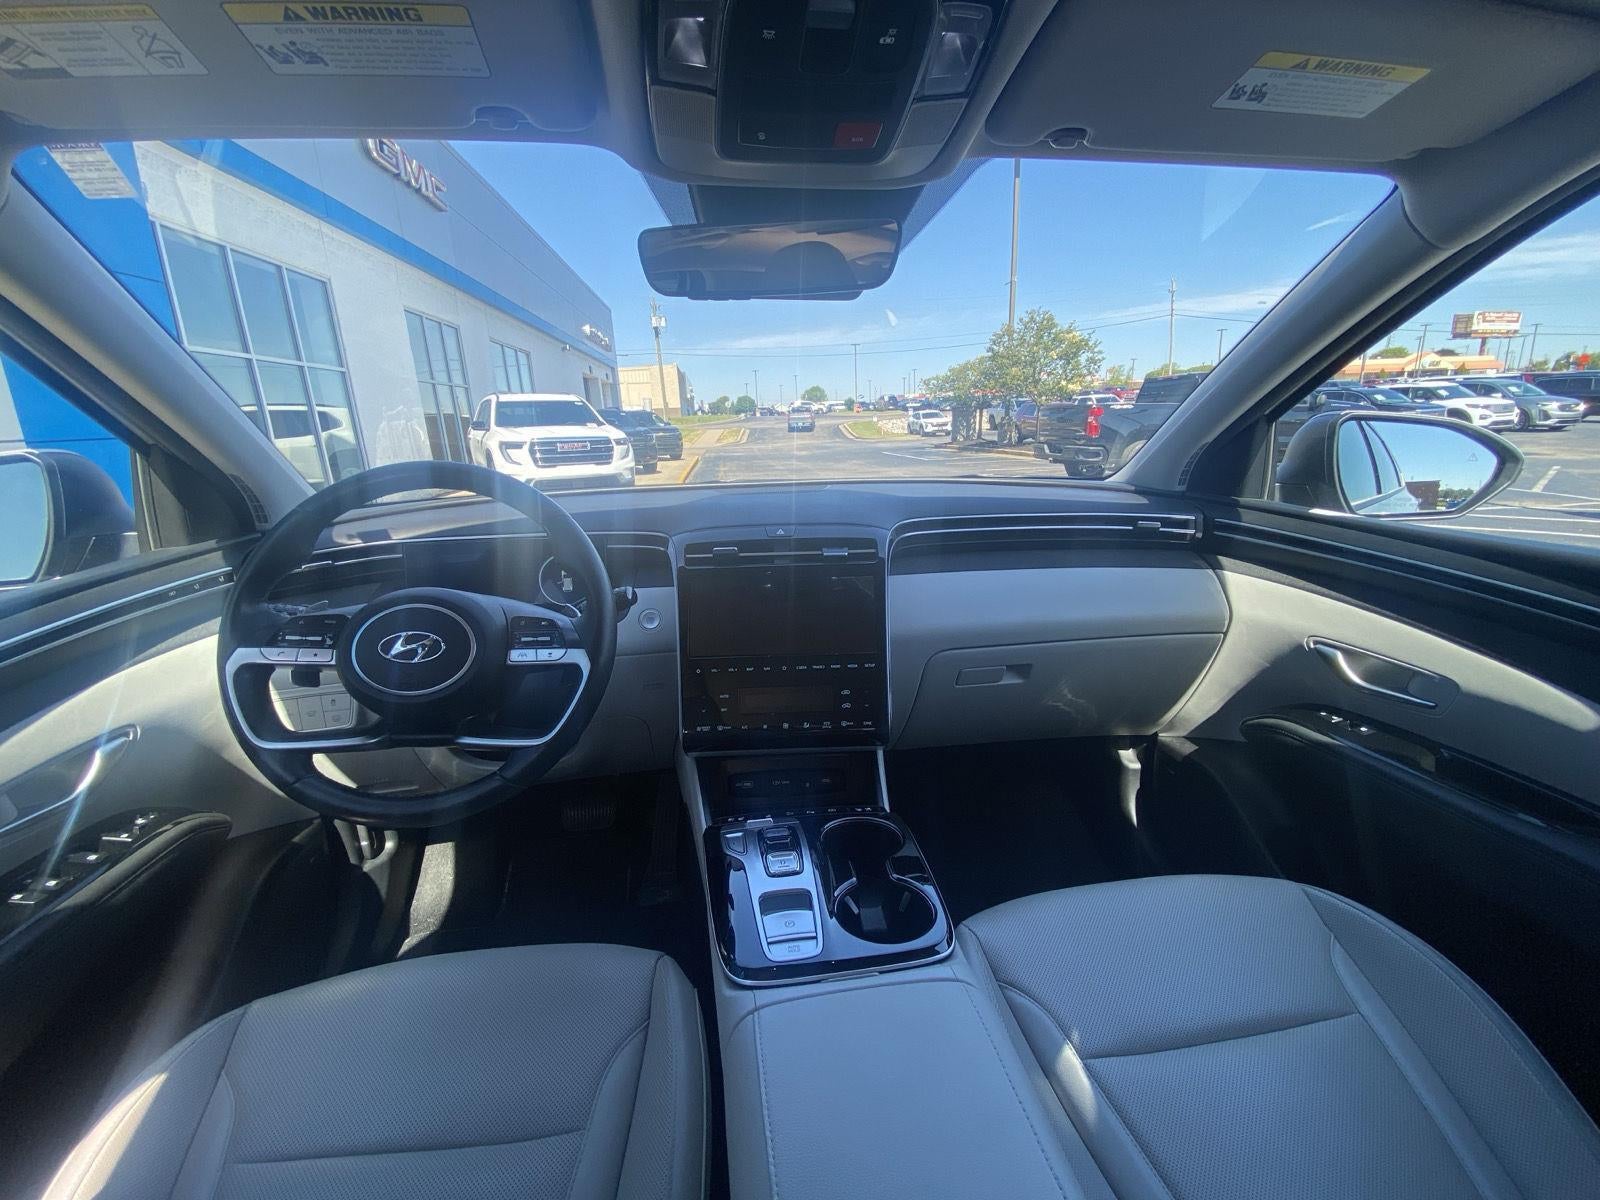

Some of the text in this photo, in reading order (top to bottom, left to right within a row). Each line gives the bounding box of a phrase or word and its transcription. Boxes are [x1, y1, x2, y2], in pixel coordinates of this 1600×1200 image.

[303, 6, 424, 23] WARNING
[1312, 59, 1396, 78] WARNING
[363, 138, 448, 212] GMC
